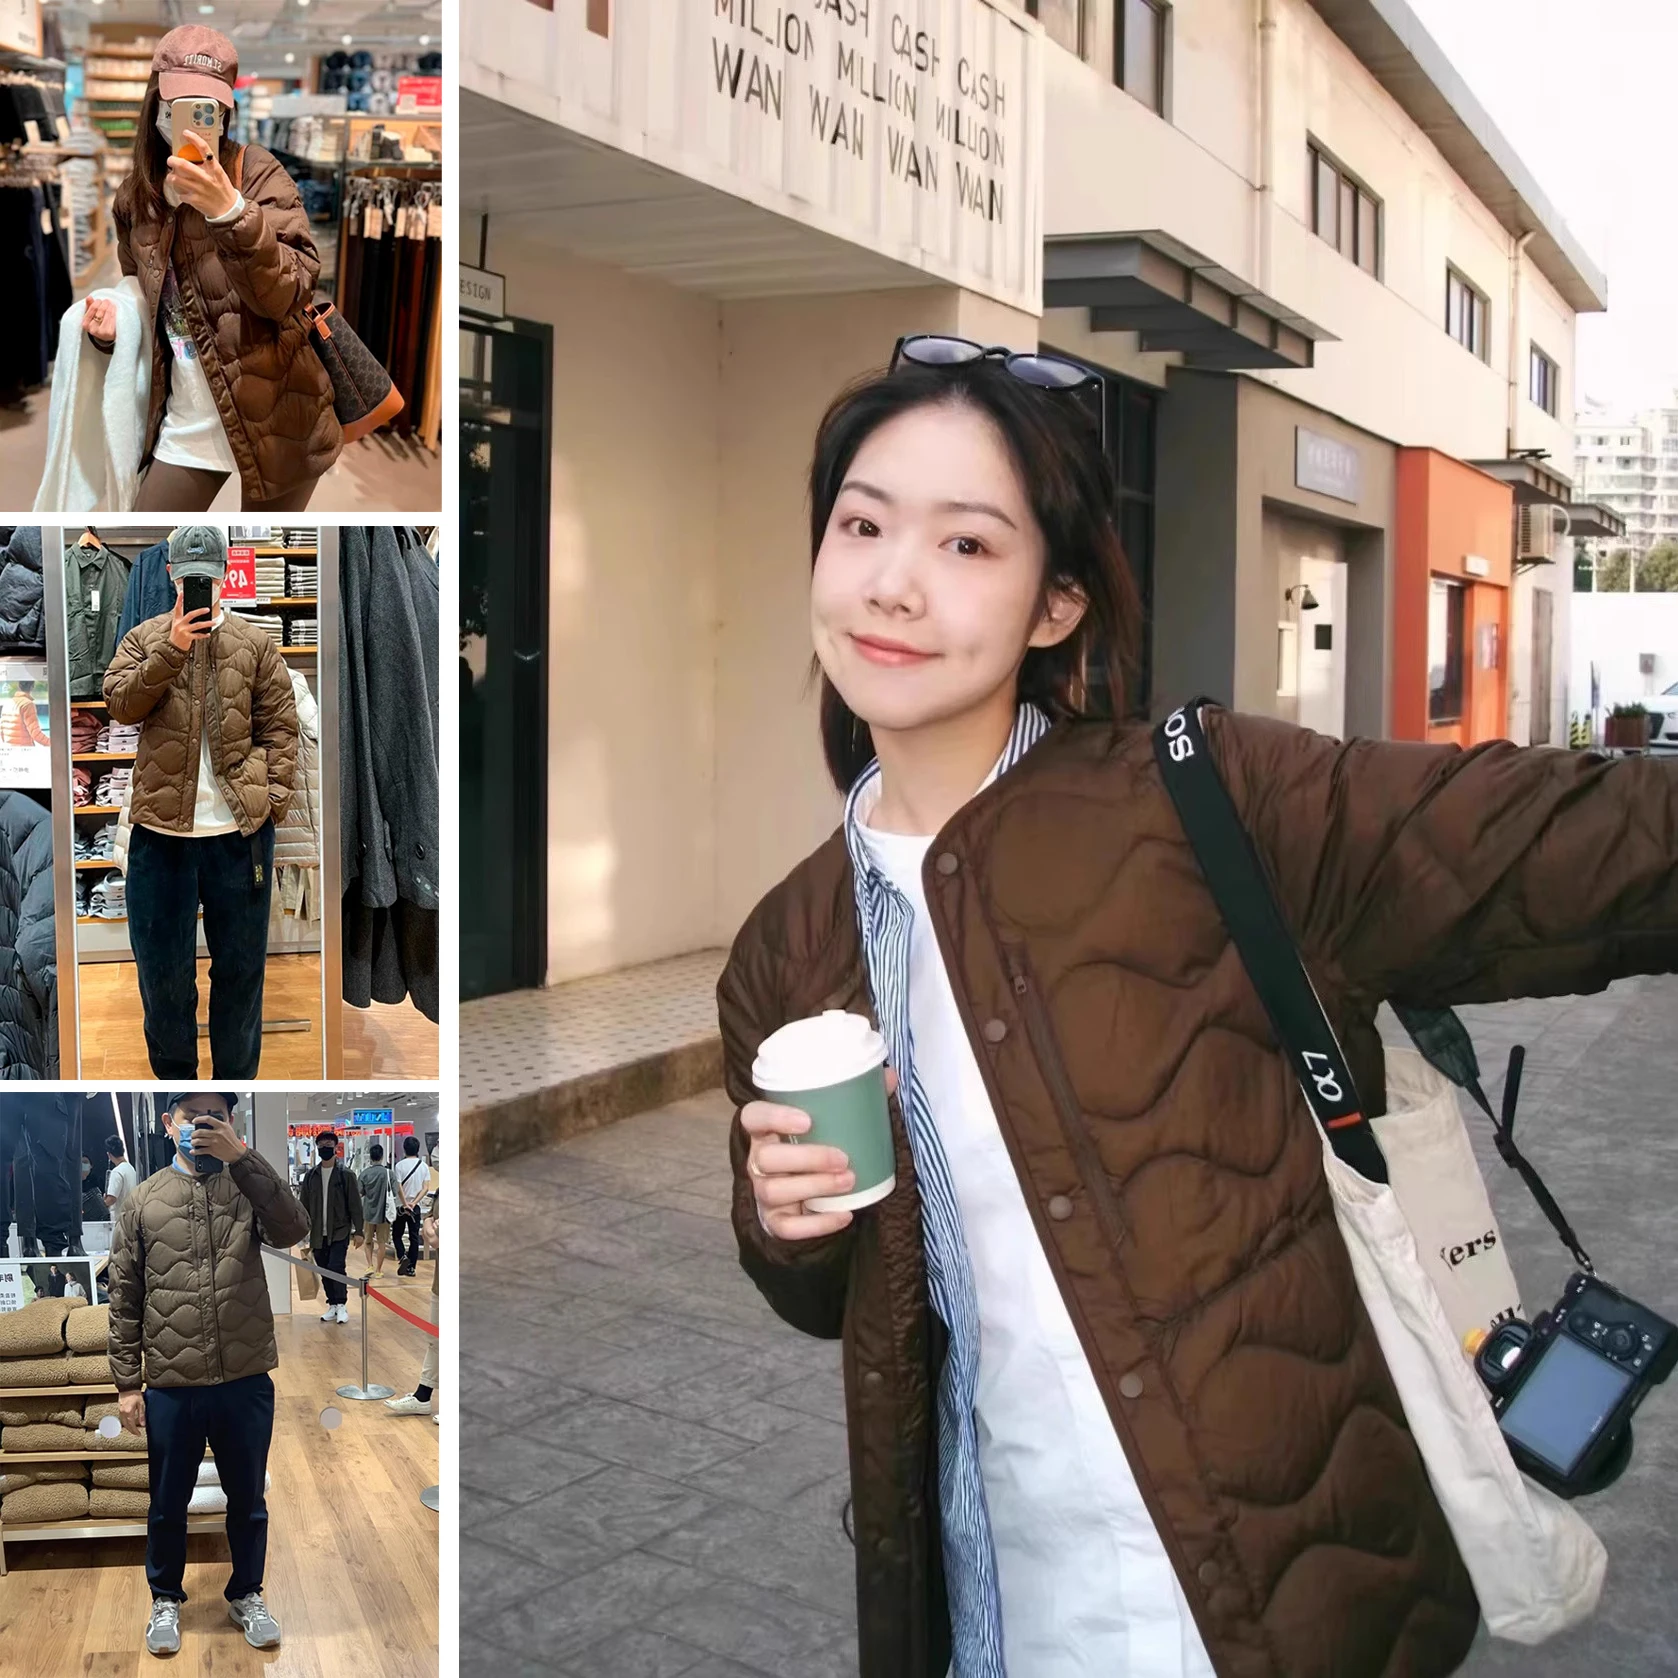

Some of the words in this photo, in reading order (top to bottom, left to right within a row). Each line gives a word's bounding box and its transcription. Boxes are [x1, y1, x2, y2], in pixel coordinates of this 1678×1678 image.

[715, 0, 815, 61] MILION
[814, 0, 869, 38] ASH
[891, 13, 940, 78] CASH
[957, 57, 1005, 119] CASH
[712, 36, 782, 121] WAN
[809, 84, 864, 161] WAN
[887, 125, 938, 192] WAN
[956, 161, 1003, 224] WAN
